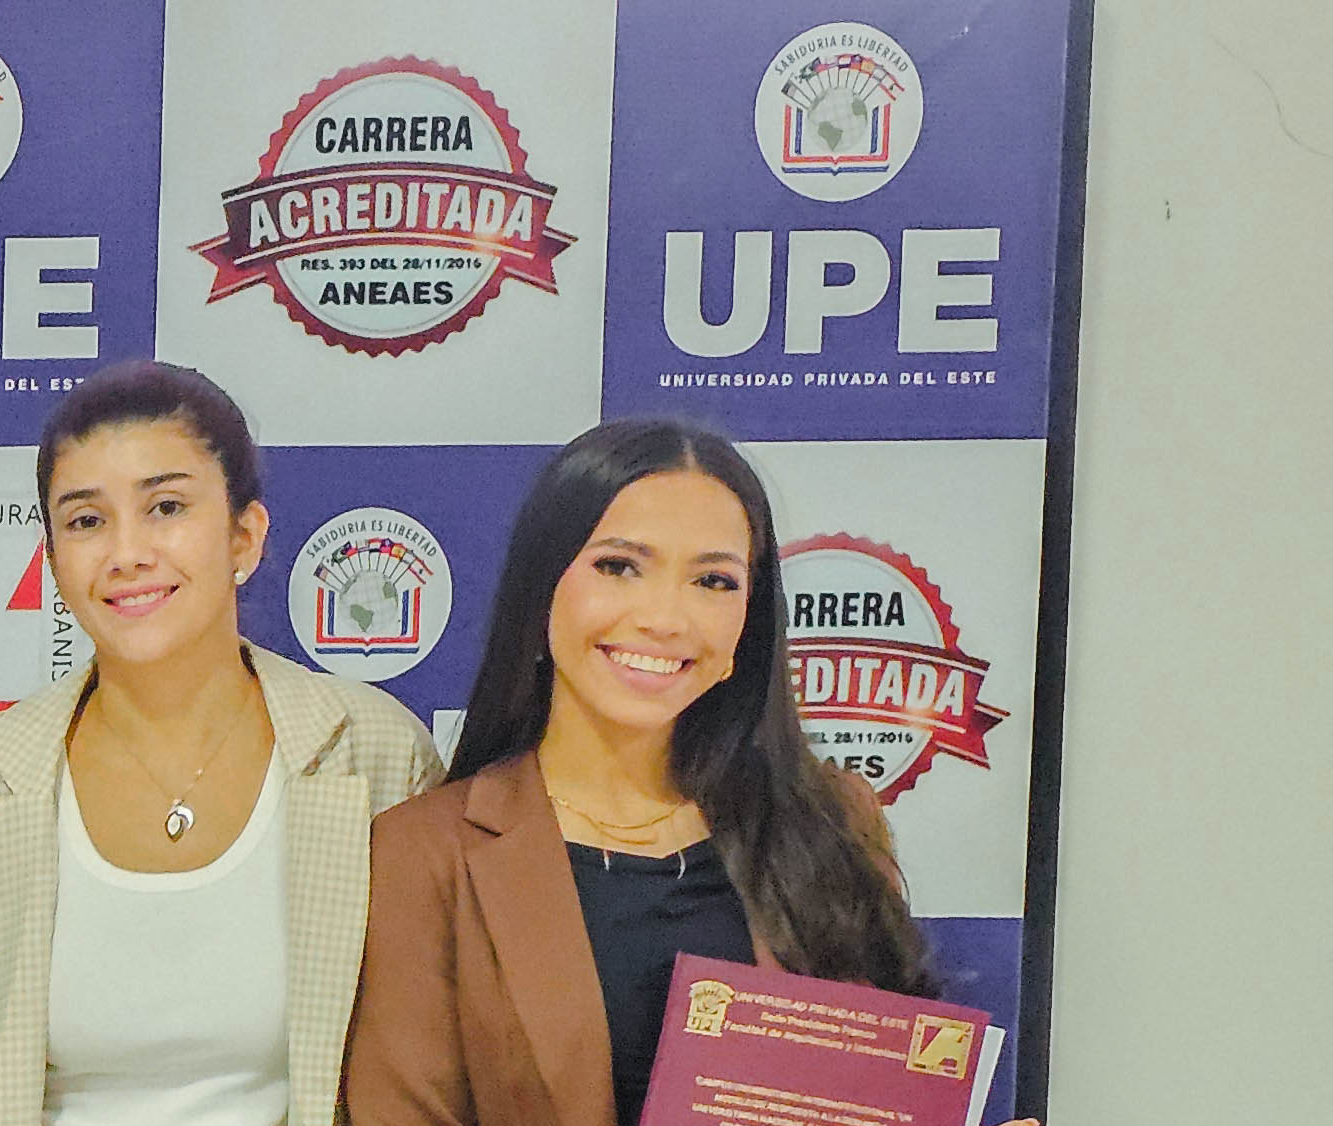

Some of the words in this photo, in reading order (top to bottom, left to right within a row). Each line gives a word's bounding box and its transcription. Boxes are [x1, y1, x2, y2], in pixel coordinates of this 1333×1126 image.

[775, 35, 837, 76] SABIDURIA
[841, 34, 853, 46] ES
[857, 36, 909, 73] LIBERTAD
[315, 117, 473, 155] CARRERA
[248, 184, 535, 249] ACREDITADA
[300, 258, 334, 270] RES.
[339, 258, 366, 270] 393
[370, 258, 398, 270] DEL
[319, 281, 454, 305] ANEAES
[663, 228, 1000, 358] UPE
[5, 378, 39, 391] DEL
[50, 378, 84, 391] ES
[660, 373, 794, 387] UNIVERSIDAD
[804, 372, 889, 387] PRIVADA
[899, 372, 936, 386] DEL
[947, 371, 996, 385] ESTE
[306, 520, 366, 558] SABIDURIA
[371, 520, 383, 531] ES
[387, 521, 437, 558] LIBERTAD
[794, 592, 905, 627] RRERA
[790, 656, 965, 717] EDITADA
